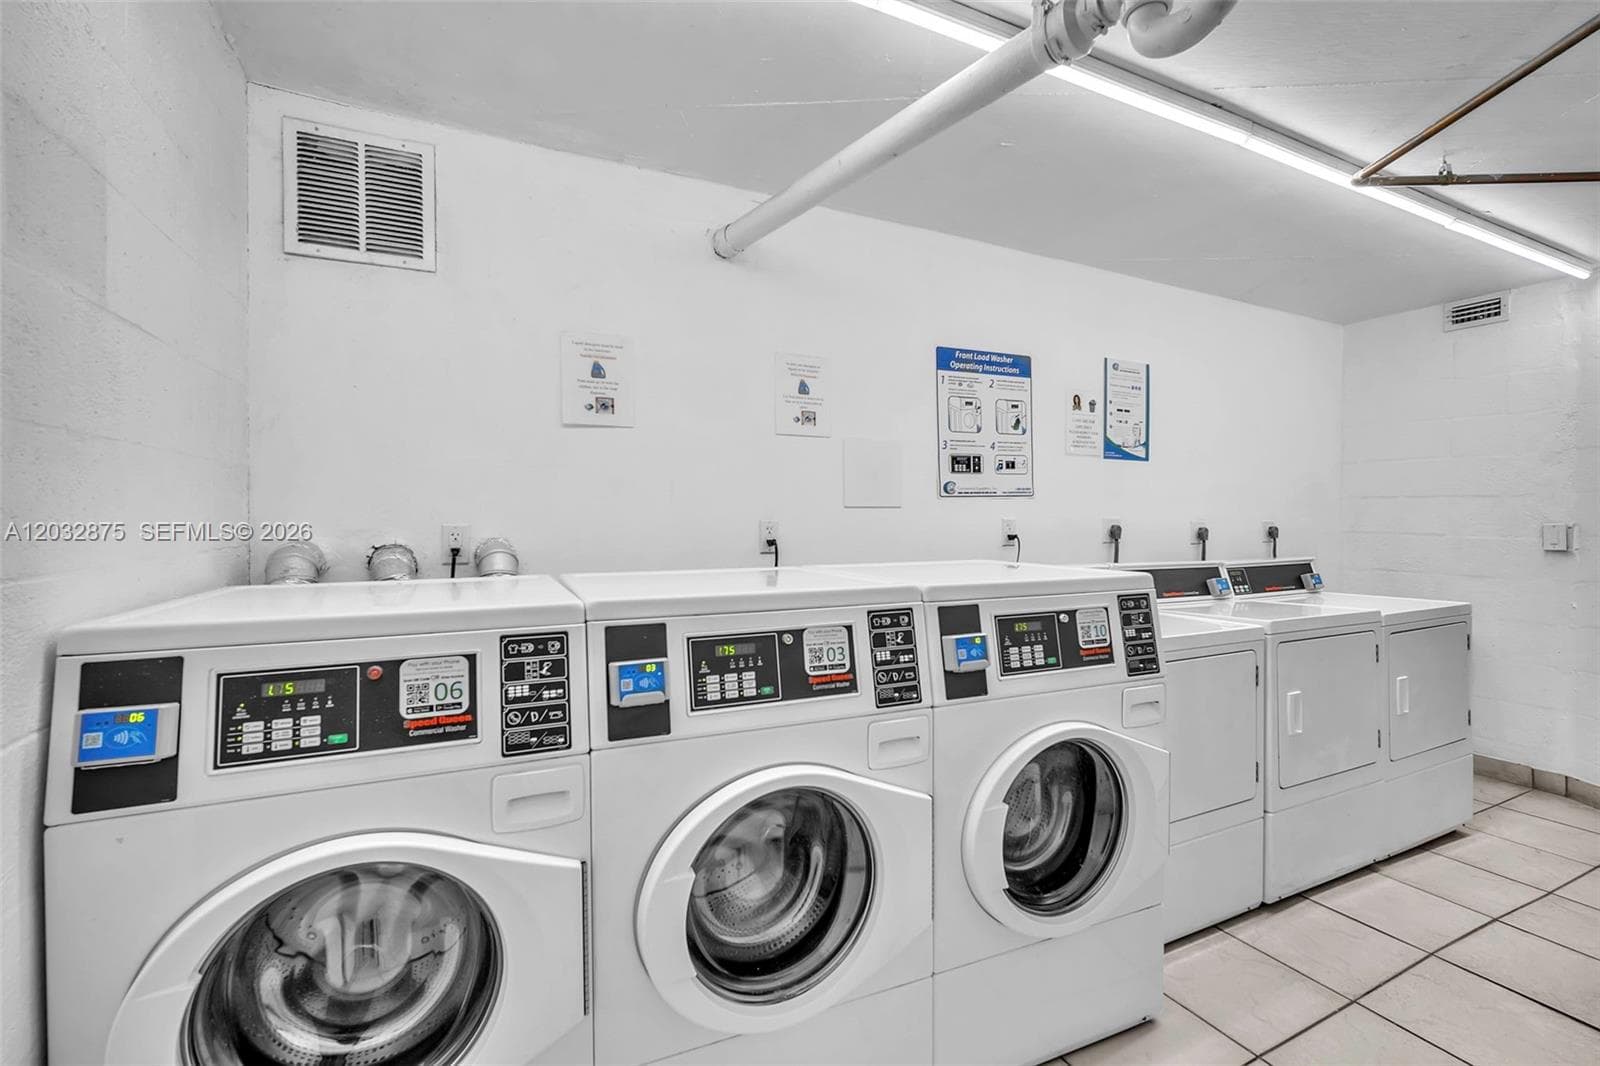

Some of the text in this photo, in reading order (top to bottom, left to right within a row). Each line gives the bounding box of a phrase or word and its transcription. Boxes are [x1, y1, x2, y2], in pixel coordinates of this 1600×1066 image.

[955, 350, 1014, 363] Front Load Washer
[949, 361, 1020, 374] Operating Instructions
[941, 375, 945, 385] 1
[989, 379, 995, 389] 2
[942, 440, 948, 450] 3
[990, 442, 996, 451] 4
[1093, 624, 1107, 637] 10
[826, 646, 846, 662] 03
[434, 681, 463, 701] 06
[128, 711, 145, 723] 06
[403, 714, 472, 729] Speed Queen
[408, 727, 445, 737] Commercial
